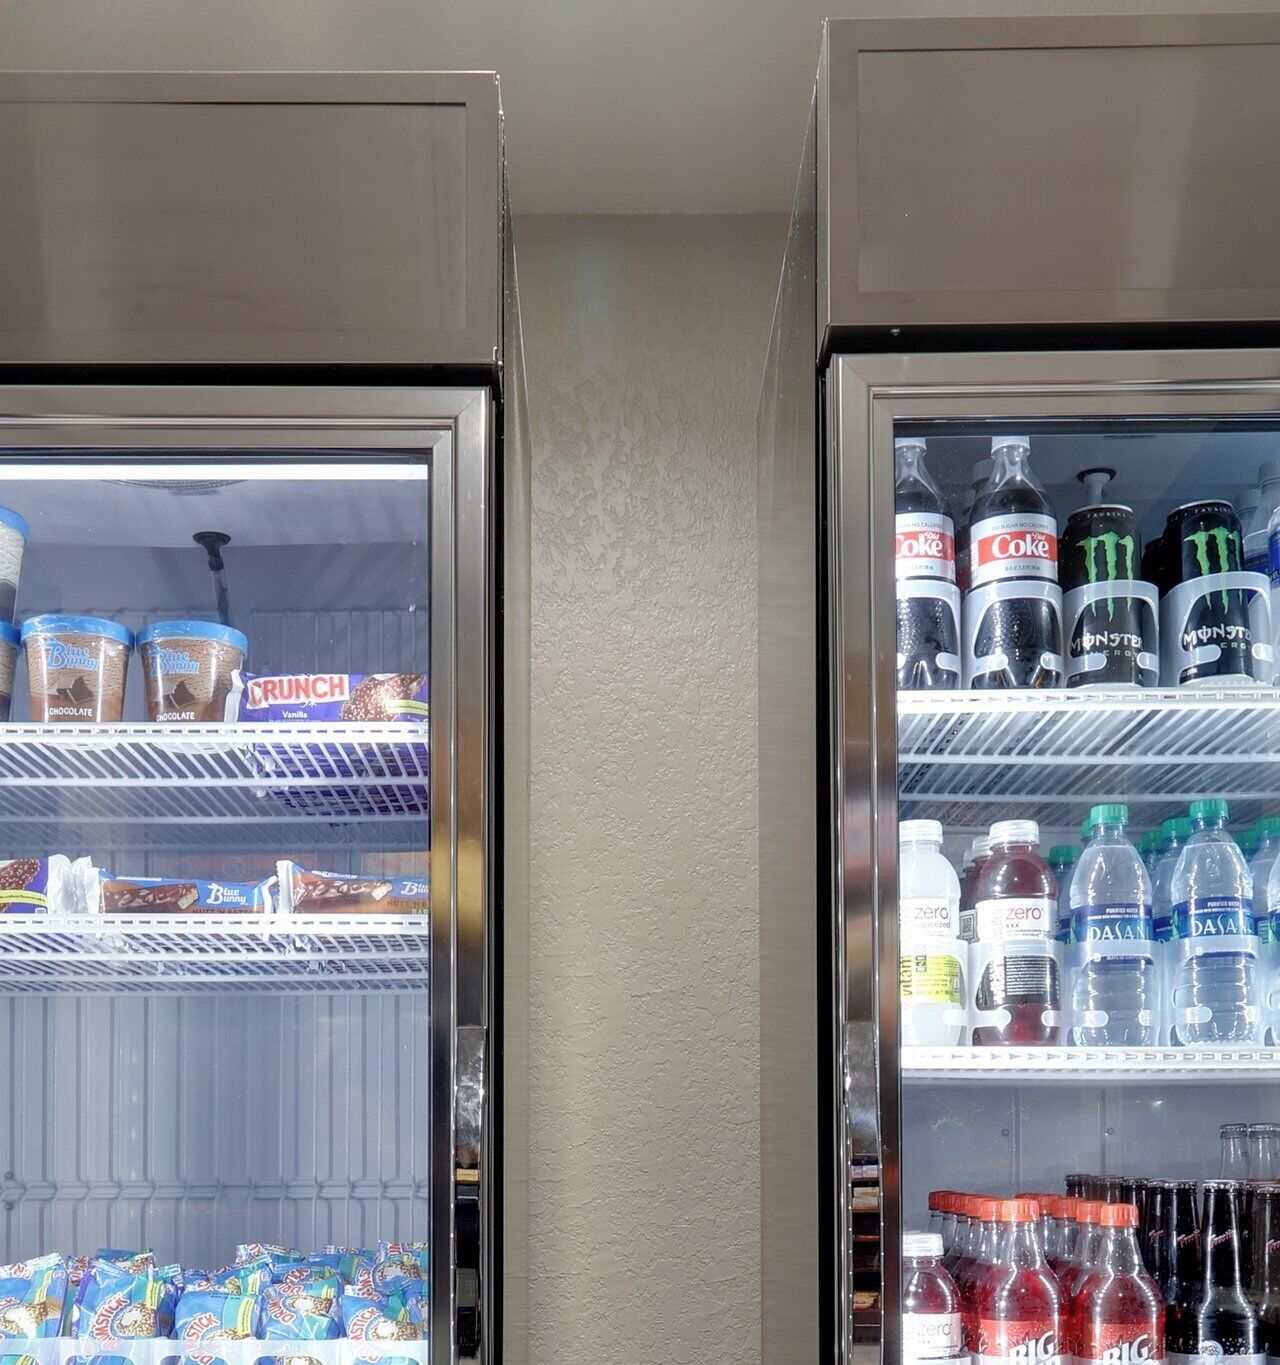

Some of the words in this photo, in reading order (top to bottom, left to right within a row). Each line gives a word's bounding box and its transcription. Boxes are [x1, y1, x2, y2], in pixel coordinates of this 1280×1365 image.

[992, 534, 1050, 559] Coke
[250, 676, 345, 706] CRUNCH
[49, 707, 93, 718] CHOCOLATE
[155, 711, 196, 722] CHOCOLATE
[282, 710, 308, 719] Vanilla
[914, 907, 949, 920] zero
[1006, 907, 1042, 920] zero
[1089, 920, 1149, 942] DASANI
[915, 1323, 950, 1337] zero
